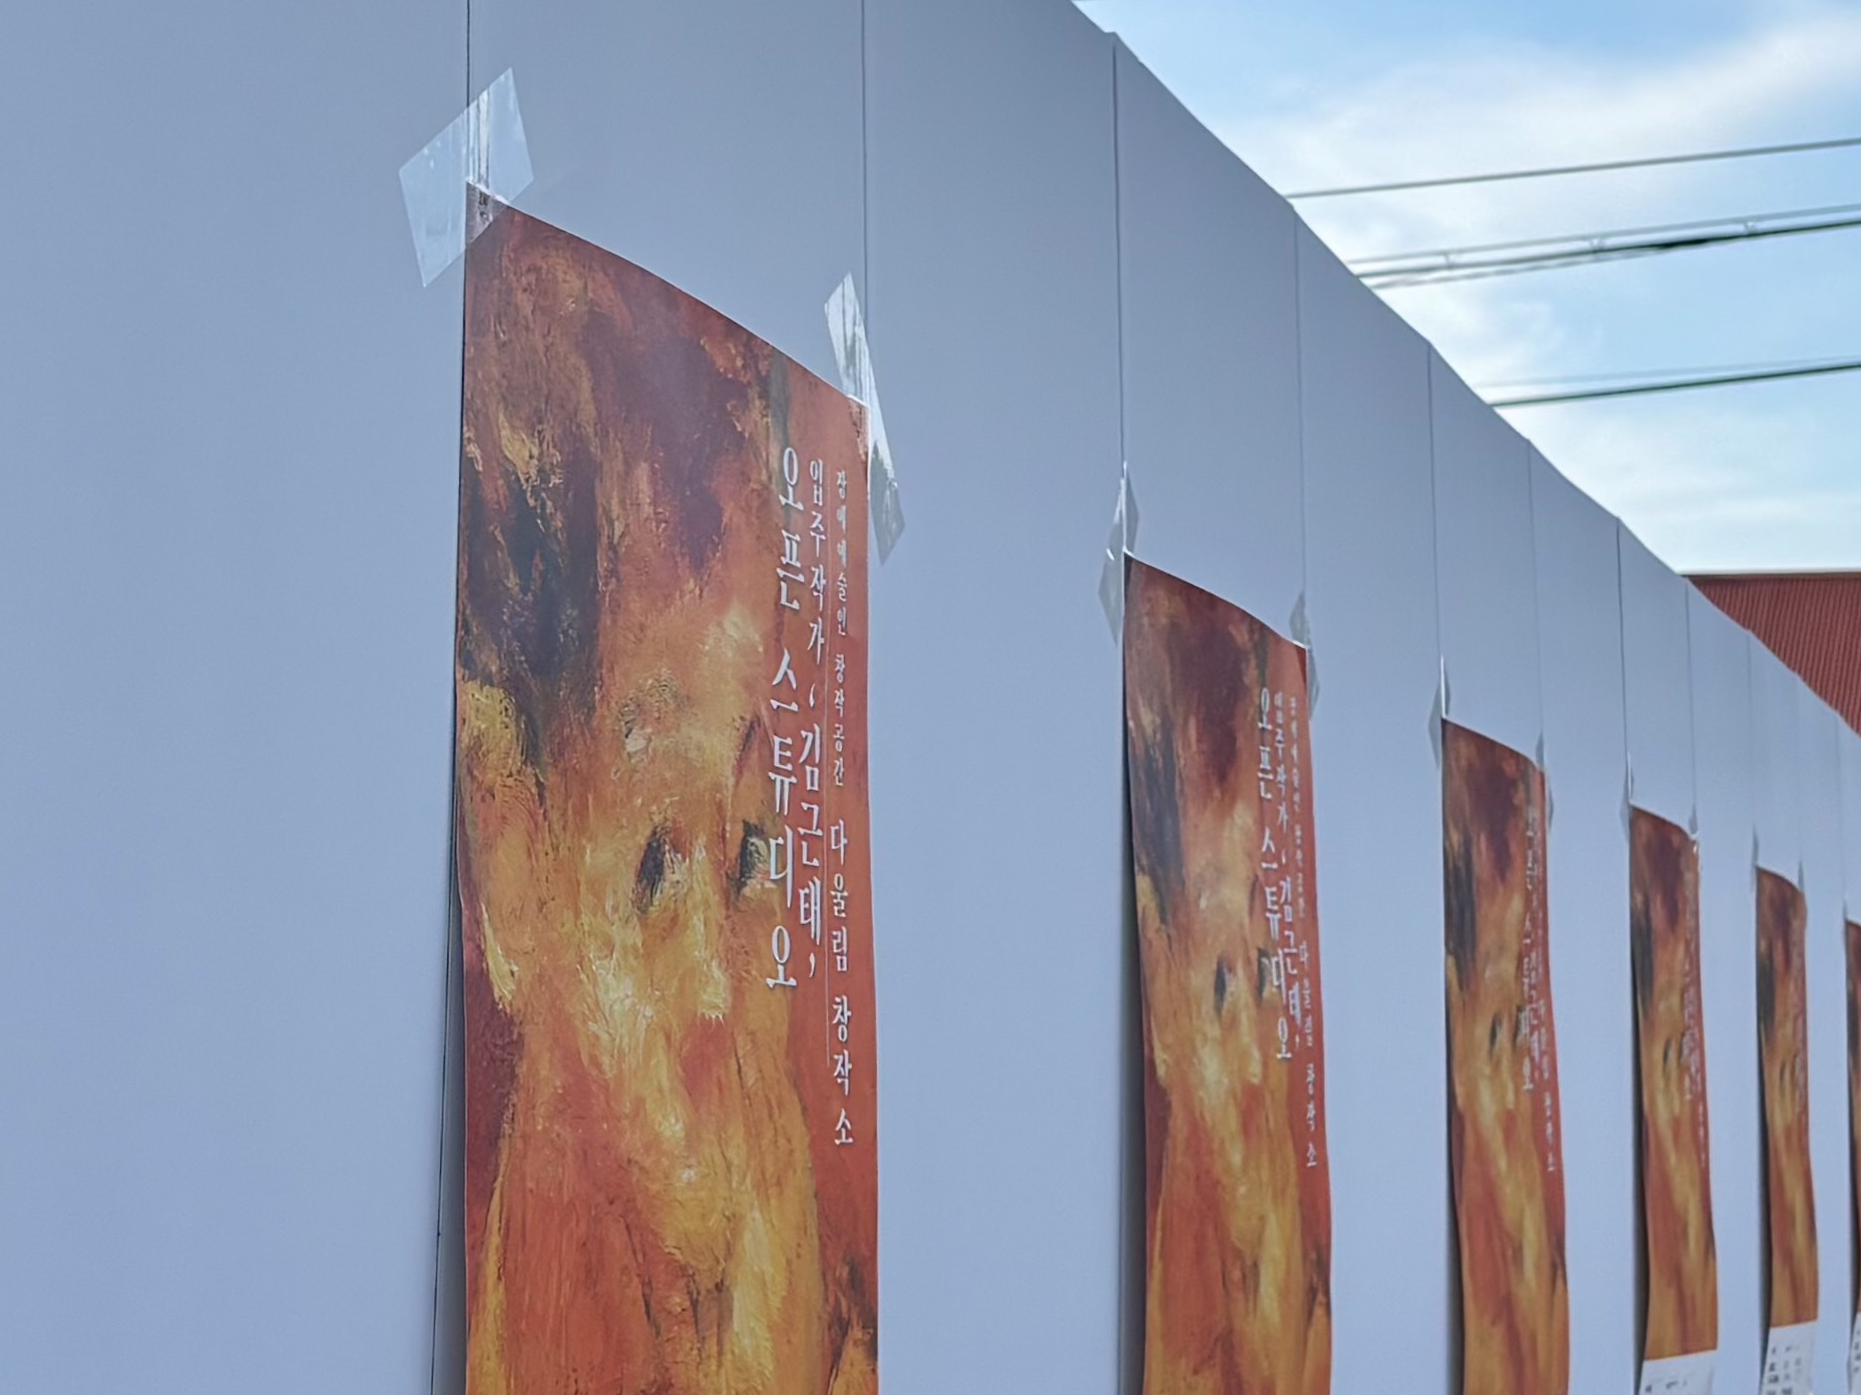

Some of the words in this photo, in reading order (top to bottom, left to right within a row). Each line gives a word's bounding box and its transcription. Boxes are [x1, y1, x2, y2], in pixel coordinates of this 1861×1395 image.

[776, 446, 805, 611] 오픈
[807, 458, 828, 666] 입주작가
[766, 648, 800, 989] 스튜디오
[830, 819, 849, 973] 다울림
[832, 995, 853, 1145] 창작소
